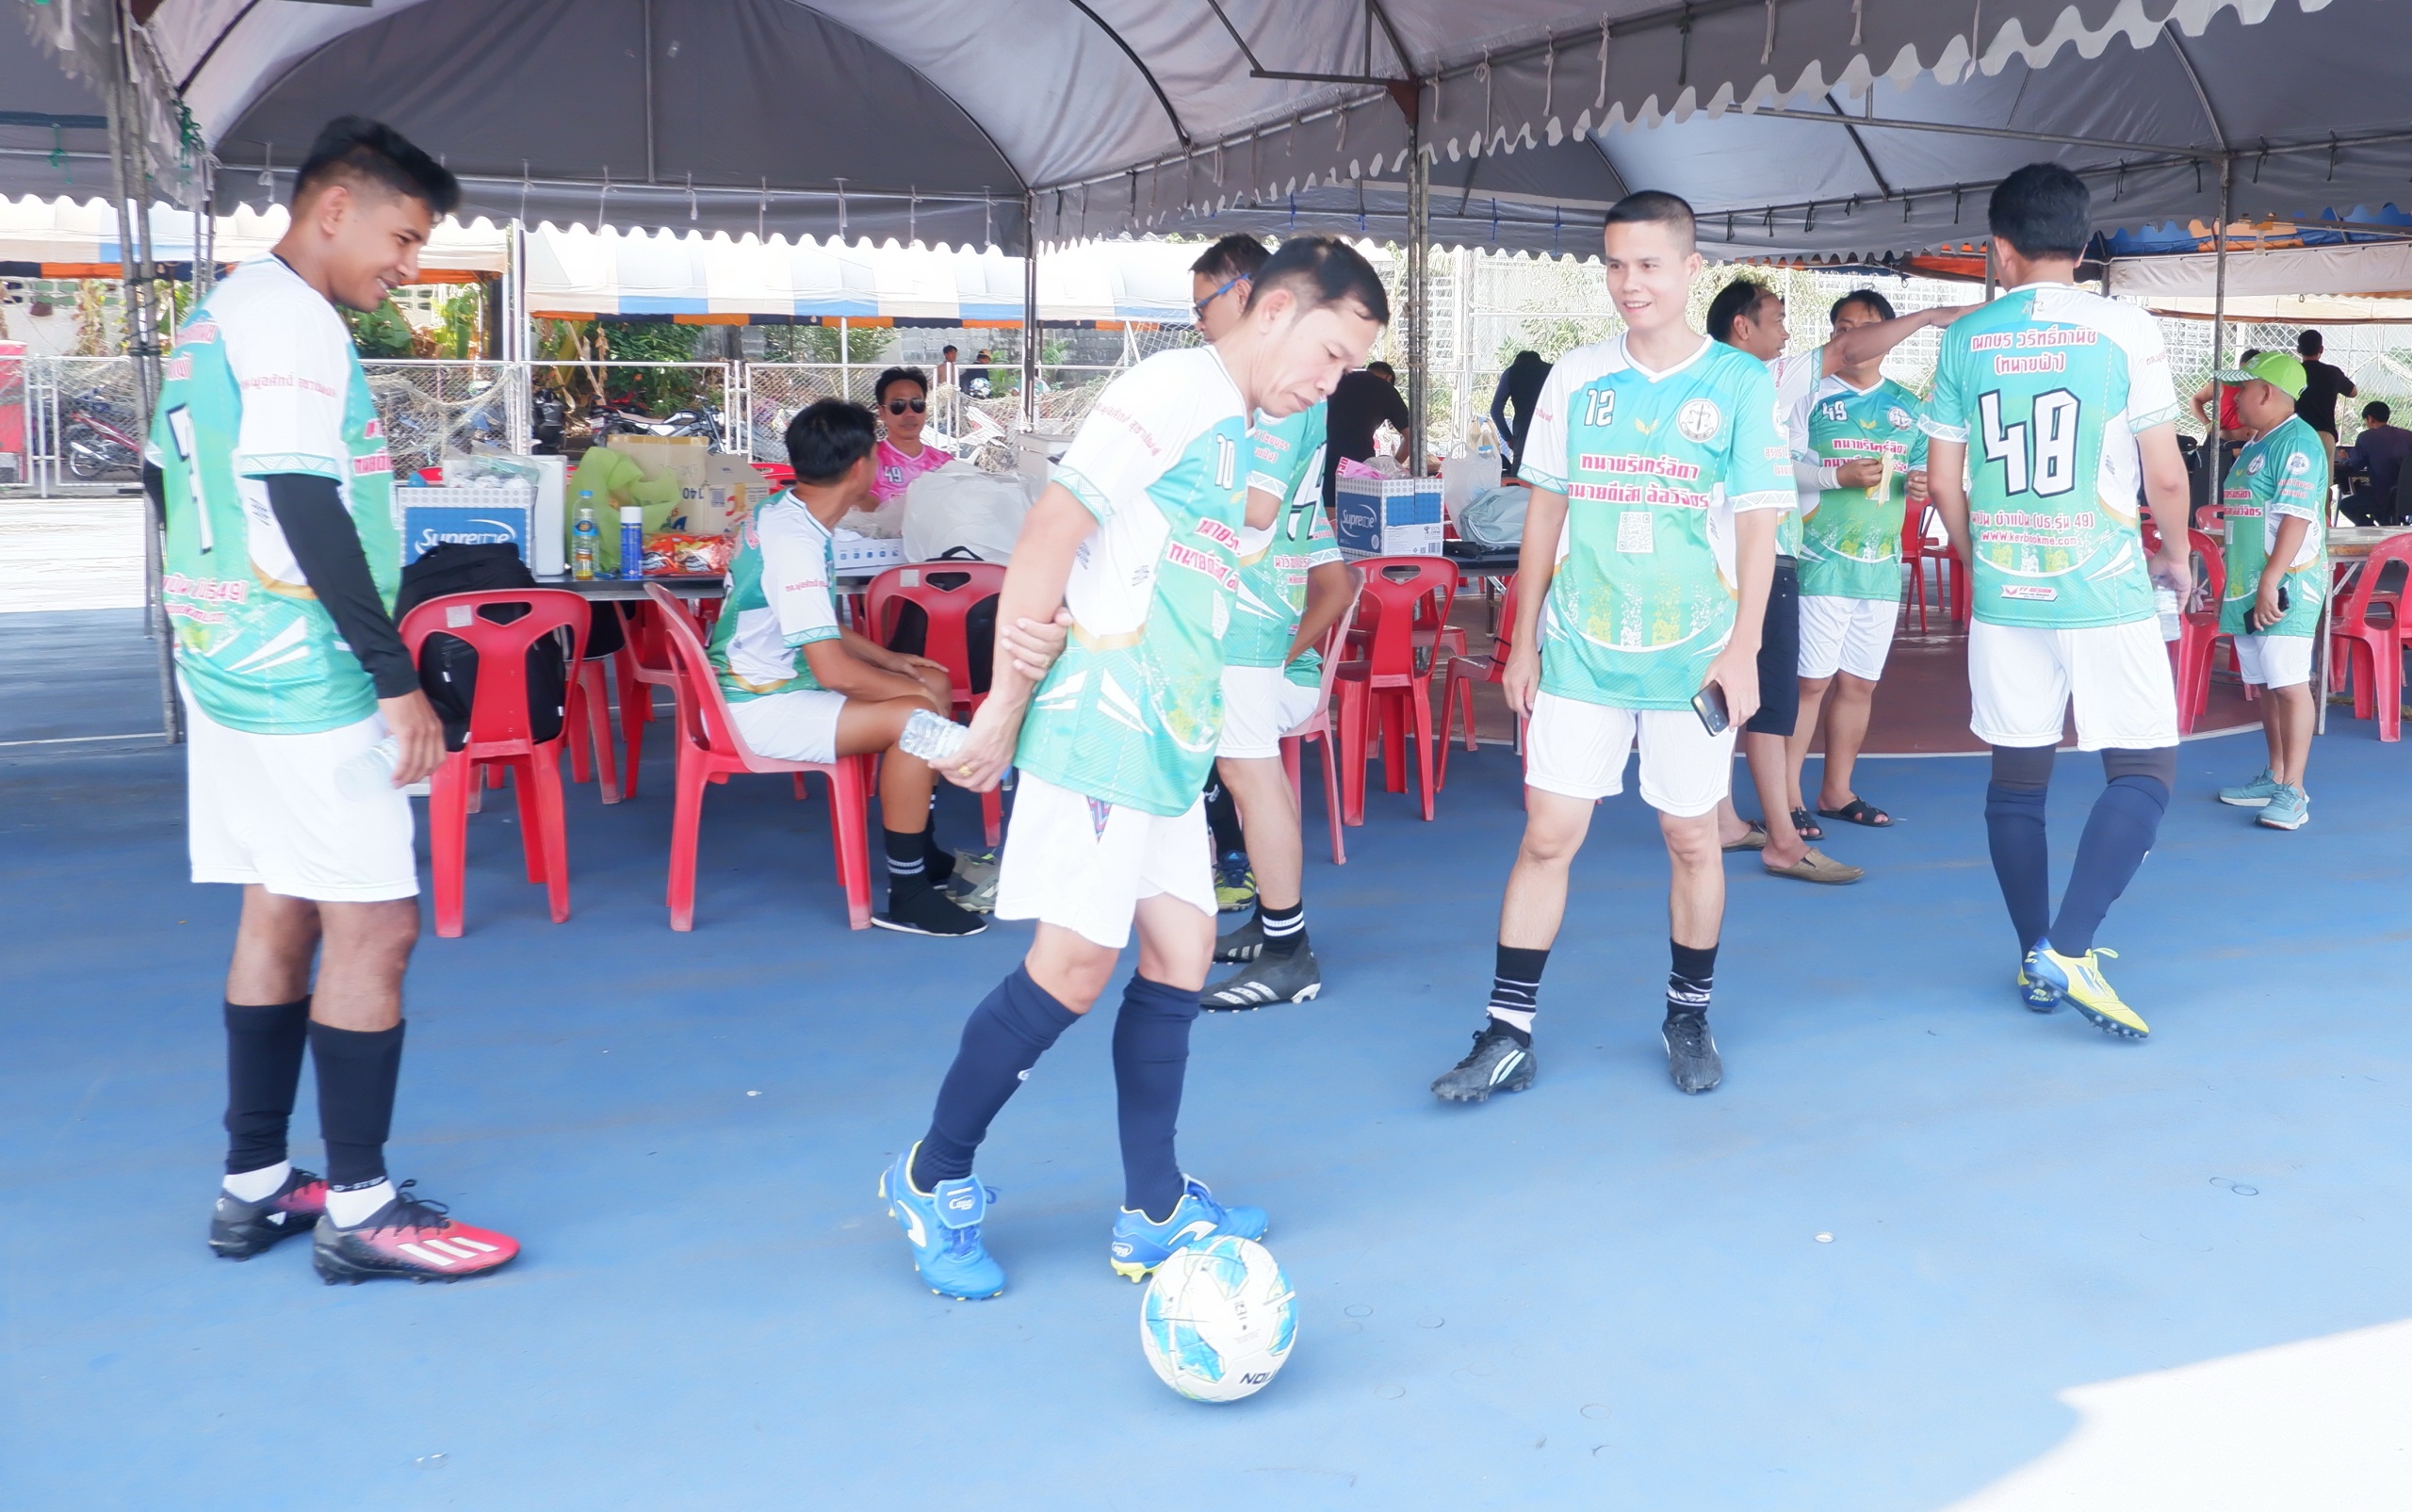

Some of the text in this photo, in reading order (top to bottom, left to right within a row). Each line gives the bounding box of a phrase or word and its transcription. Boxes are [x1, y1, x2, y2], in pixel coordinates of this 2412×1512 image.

[1584, 388, 1616, 428] 12
[1821, 399, 1849, 422] 49
[1978, 387, 2082, 499] 48
[883, 465, 904, 483] 49
[1342, 510, 1375, 529] Supreme
[2075, 512, 2094, 528] 49)
